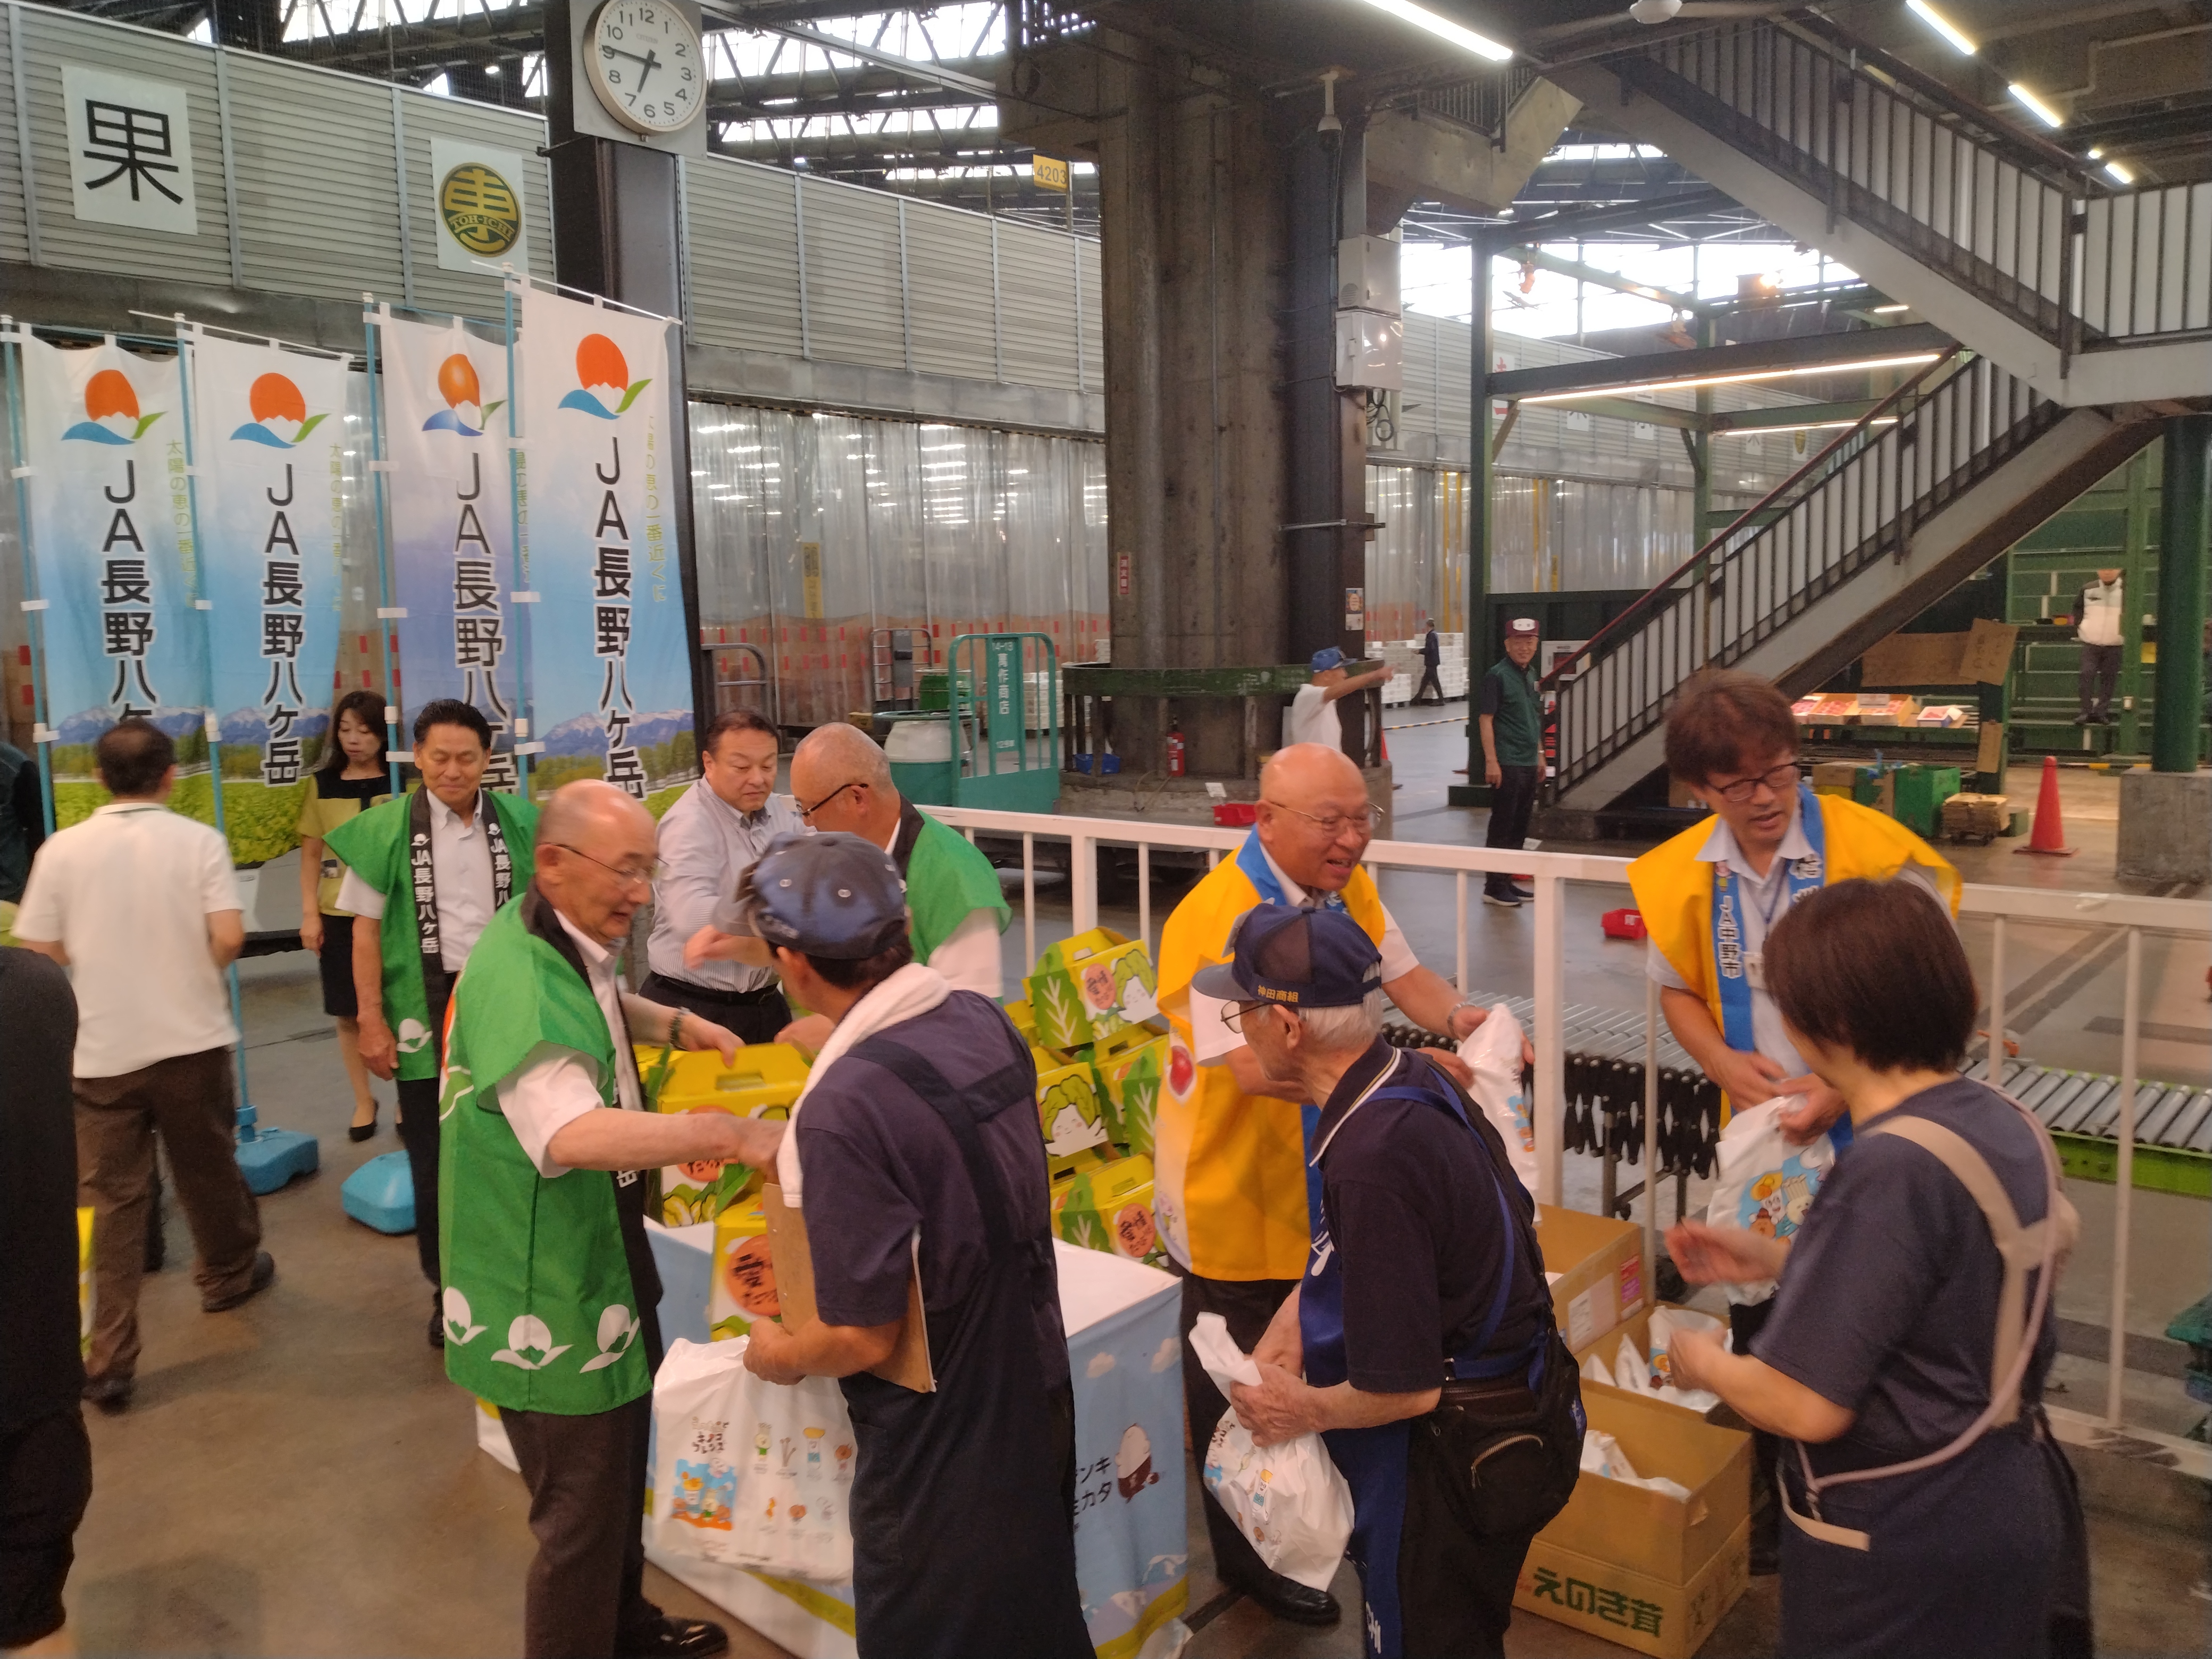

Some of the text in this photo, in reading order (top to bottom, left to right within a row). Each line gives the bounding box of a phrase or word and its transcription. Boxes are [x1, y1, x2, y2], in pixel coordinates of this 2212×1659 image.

[619, 10, 633, 26] 11
[639, 8, 655, 24] 12
[607, 24, 623, 40] 10
[664, 21, 668, 34] 1
[602, 45, 615, 60] 9
[675, 43, 686, 57] 2
[609, 70, 621, 83] 8
[681, 67, 692, 81] 3
[625, 93, 636, 106] 7
[675, 88, 687, 101] 4
[644, 104, 656, 118] 6
[664, 102, 675, 116] 5
[83, 98, 183, 205] 果
[1036, 164, 1066, 185] 4203
[450, 215, 513, 240] TOH-ICHI
[1076, 1456, 1112, 1485] ンキ
[1533, 1566, 1663, 1638] えのき茸
